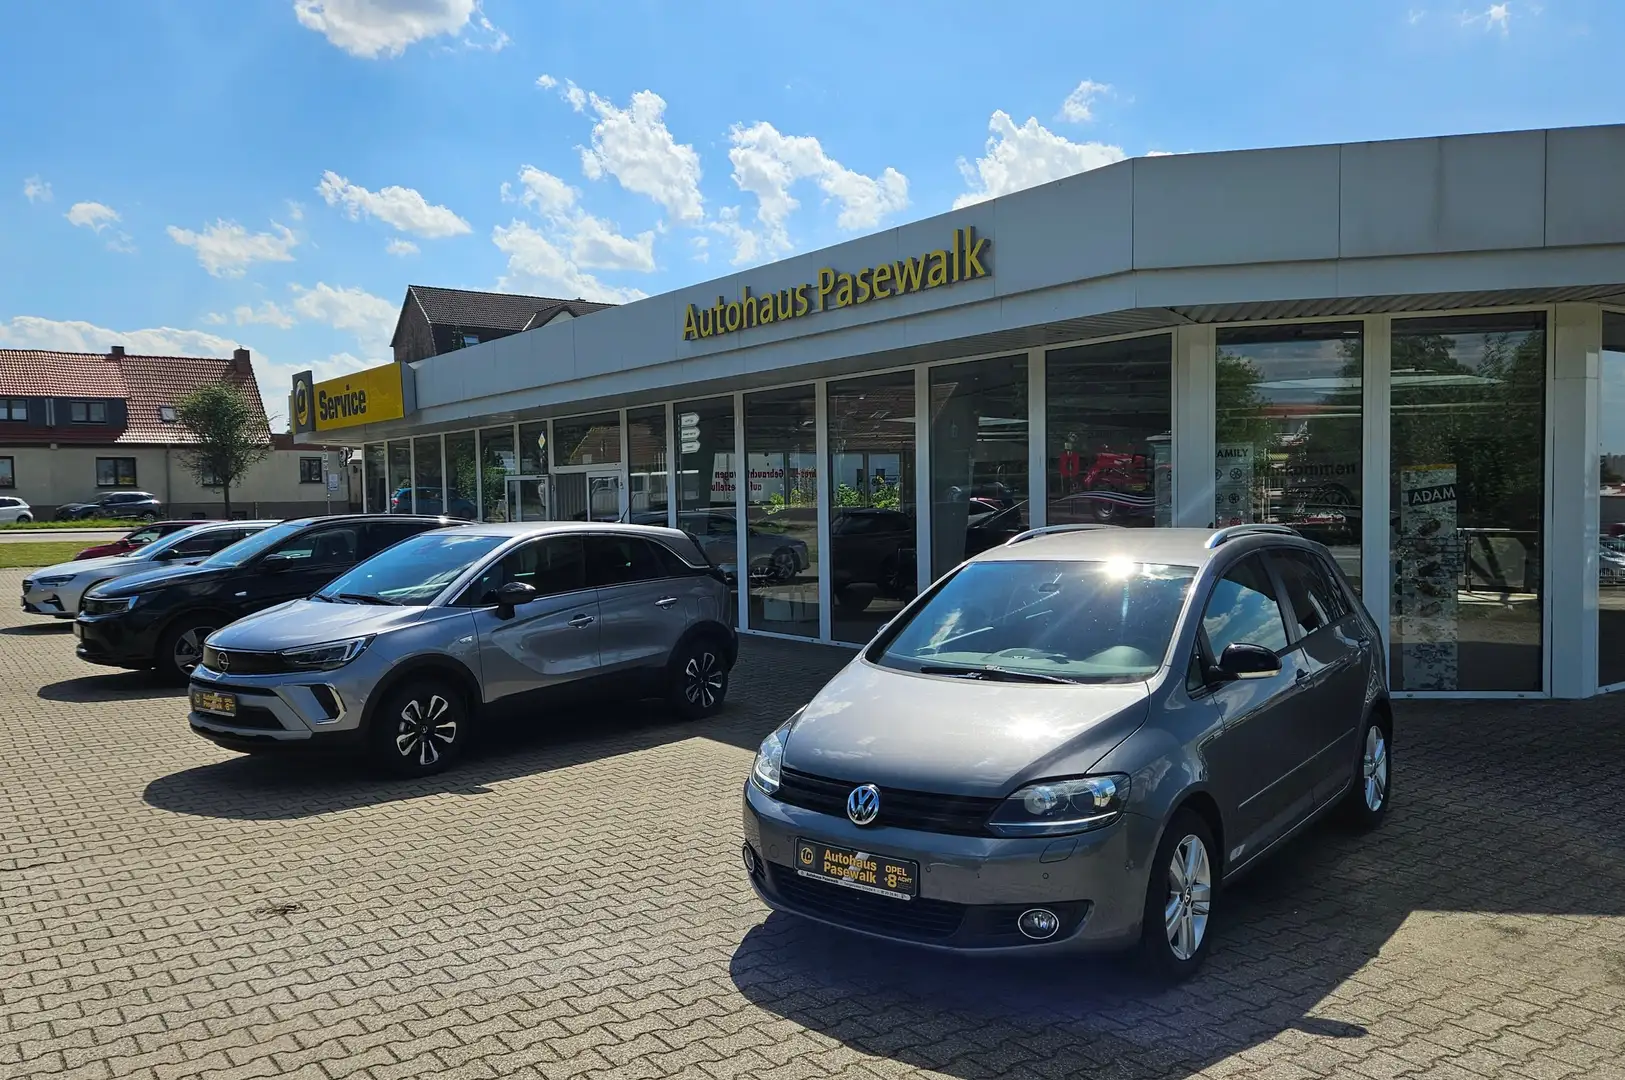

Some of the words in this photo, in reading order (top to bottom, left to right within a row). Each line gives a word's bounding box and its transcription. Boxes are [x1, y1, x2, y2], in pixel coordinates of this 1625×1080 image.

[683, 284, 812, 341] Autohaus
[817, 226, 991, 312] Pasewalk
[318, 383, 367, 421] Service
[1215, 448, 1248, 459] AMILY
[1412, 485, 1456, 504] ADAM
[824, 849, 877, 871] Autohaus
[885, 865, 908, 877] OPEL
[824, 861, 877, 884] Pasewalk
